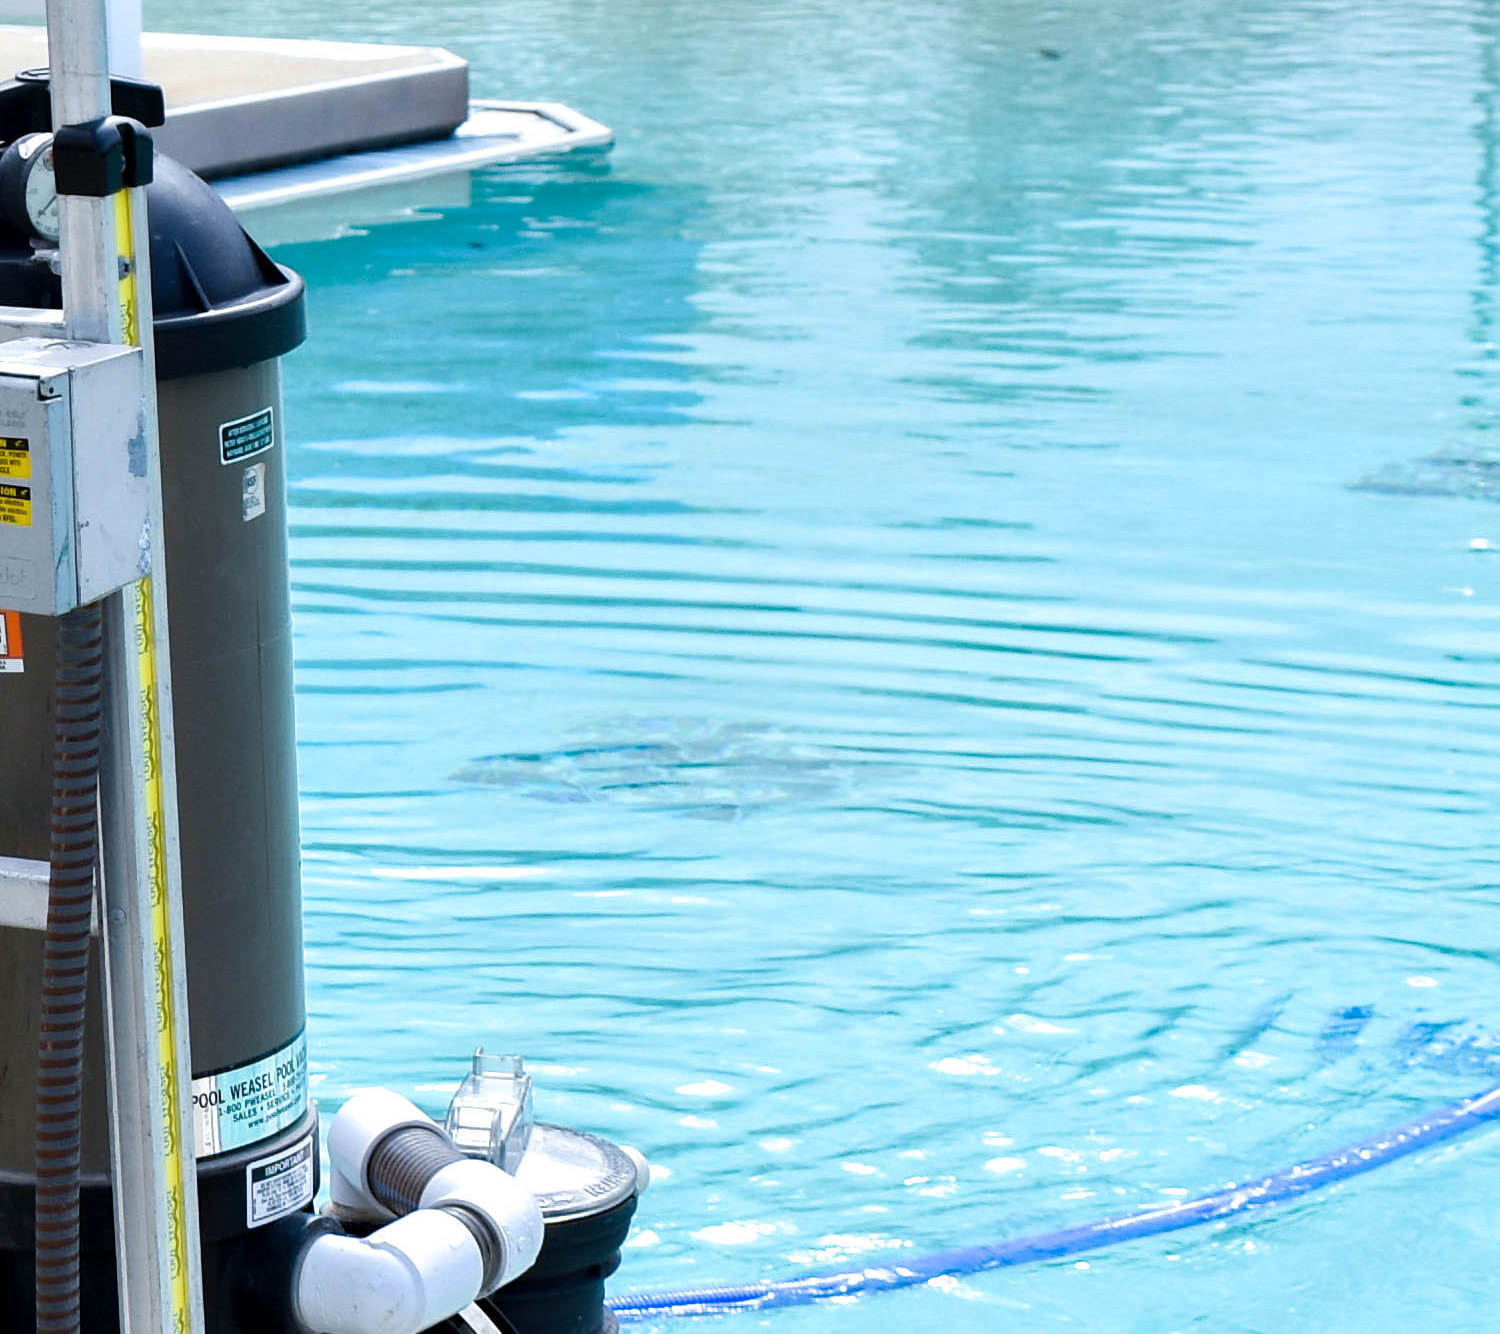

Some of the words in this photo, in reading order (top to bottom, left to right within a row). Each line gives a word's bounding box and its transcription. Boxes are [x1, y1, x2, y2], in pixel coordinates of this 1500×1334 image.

[192, 1089, 226, 1109] POOL
[230, 1070, 274, 1101] WEASEL
[276, 1059, 296, 1083] POOL
[233, 1108, 258, 1123] SALES
[264, 1150, 305, 1177] IMPORTANT
